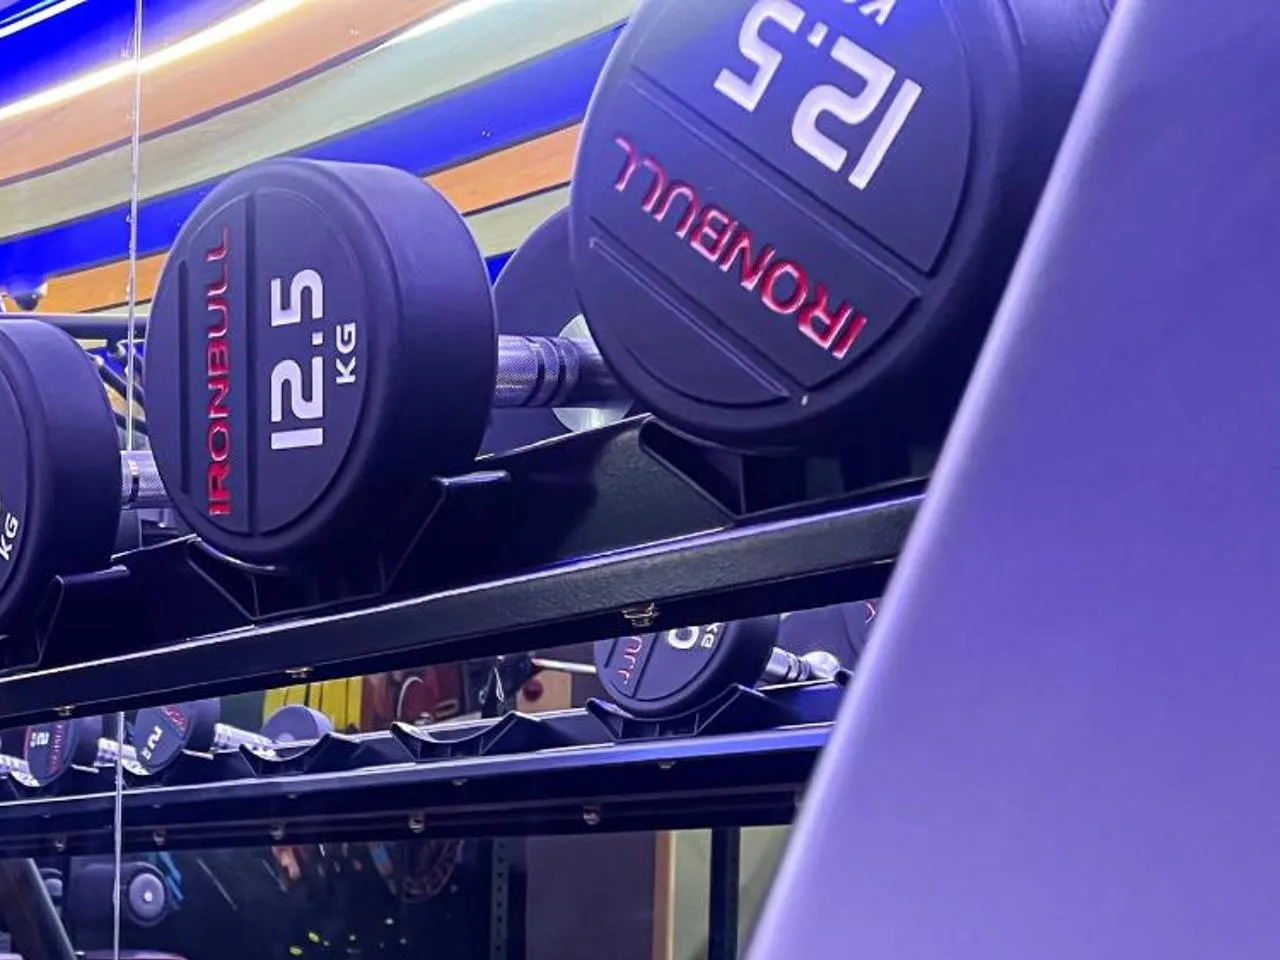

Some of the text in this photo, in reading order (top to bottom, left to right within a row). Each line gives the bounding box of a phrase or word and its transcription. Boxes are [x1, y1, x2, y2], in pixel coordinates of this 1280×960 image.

[713, 0, 922, 190] 12.5
[615, 137, 868, 359] IRONBULL
[202, 227, 233, 517] IRONBULL
[270, 268, 323, 451] 12.5
[334, 321, 357, 385] KG
